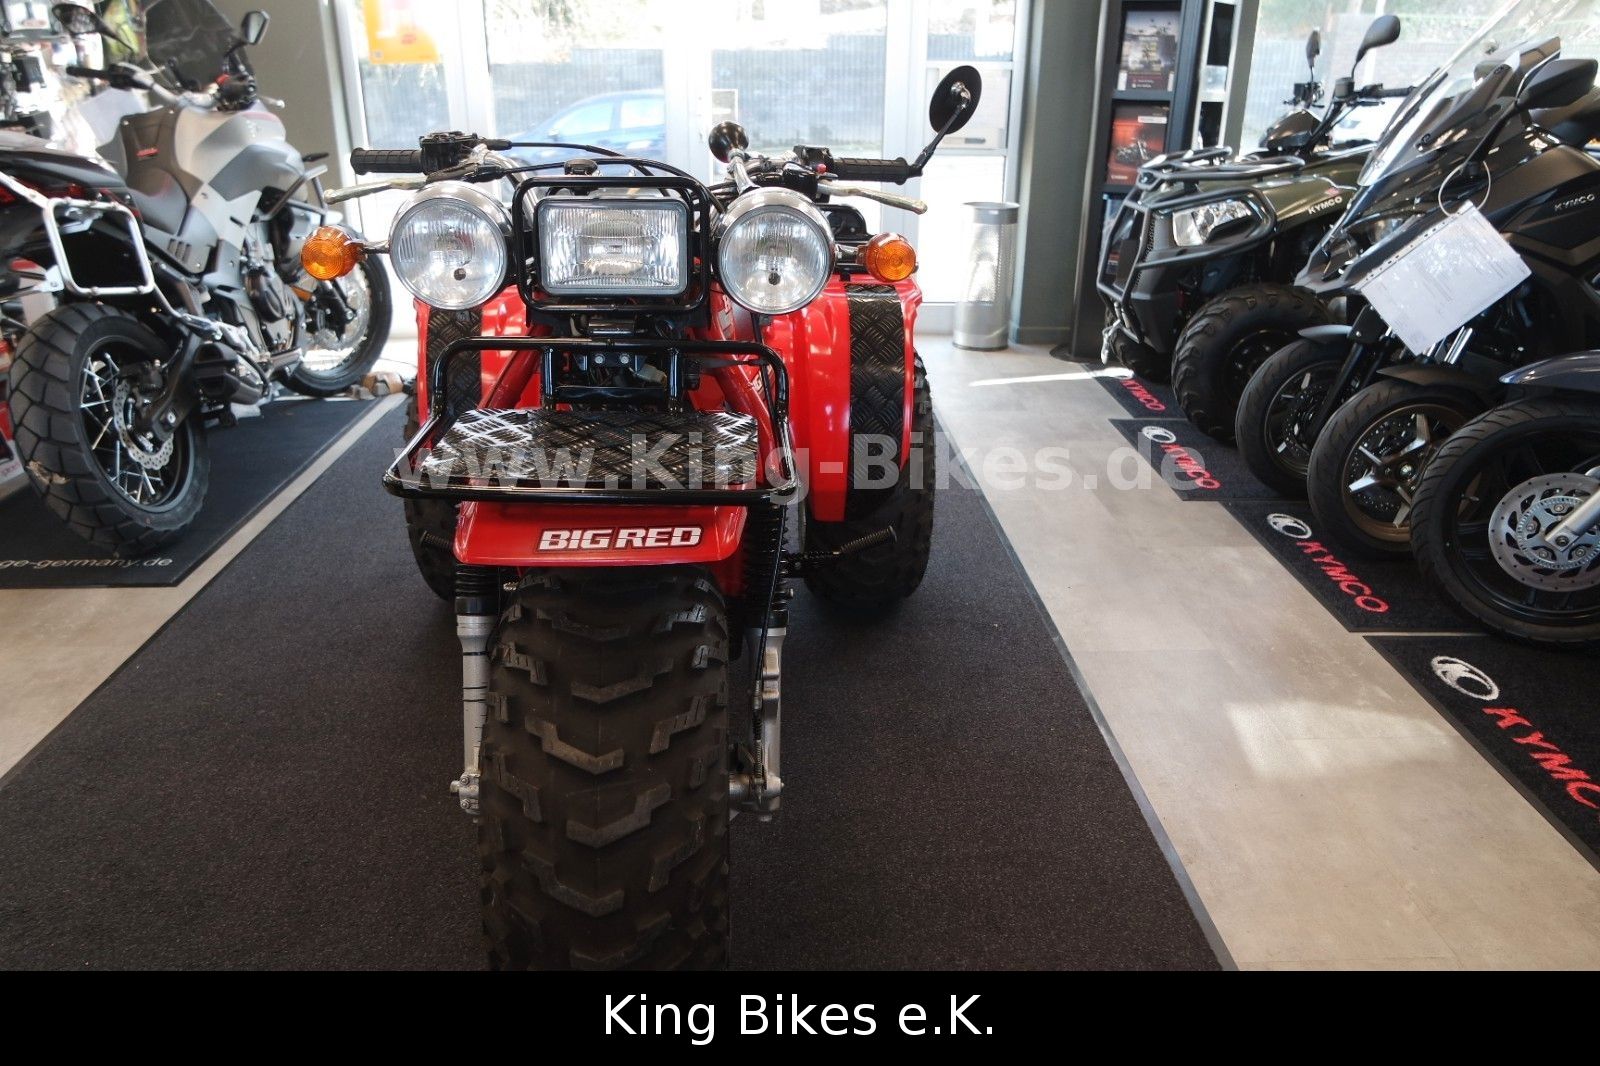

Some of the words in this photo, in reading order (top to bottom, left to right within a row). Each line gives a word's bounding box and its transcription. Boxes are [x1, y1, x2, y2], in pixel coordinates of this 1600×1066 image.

[1308, 195, 1343, 215] KYMCO
[1554, 193, 1596, 212] KYMCO
[1161, 442, 1222, 490] KYMCO
[538, 528, 613, 551] BIG
[615, 526, 702, 549] RED
[1296, 541, 1390, 614] KYMCO
[1482, 706, 1600, 822] KYMC
